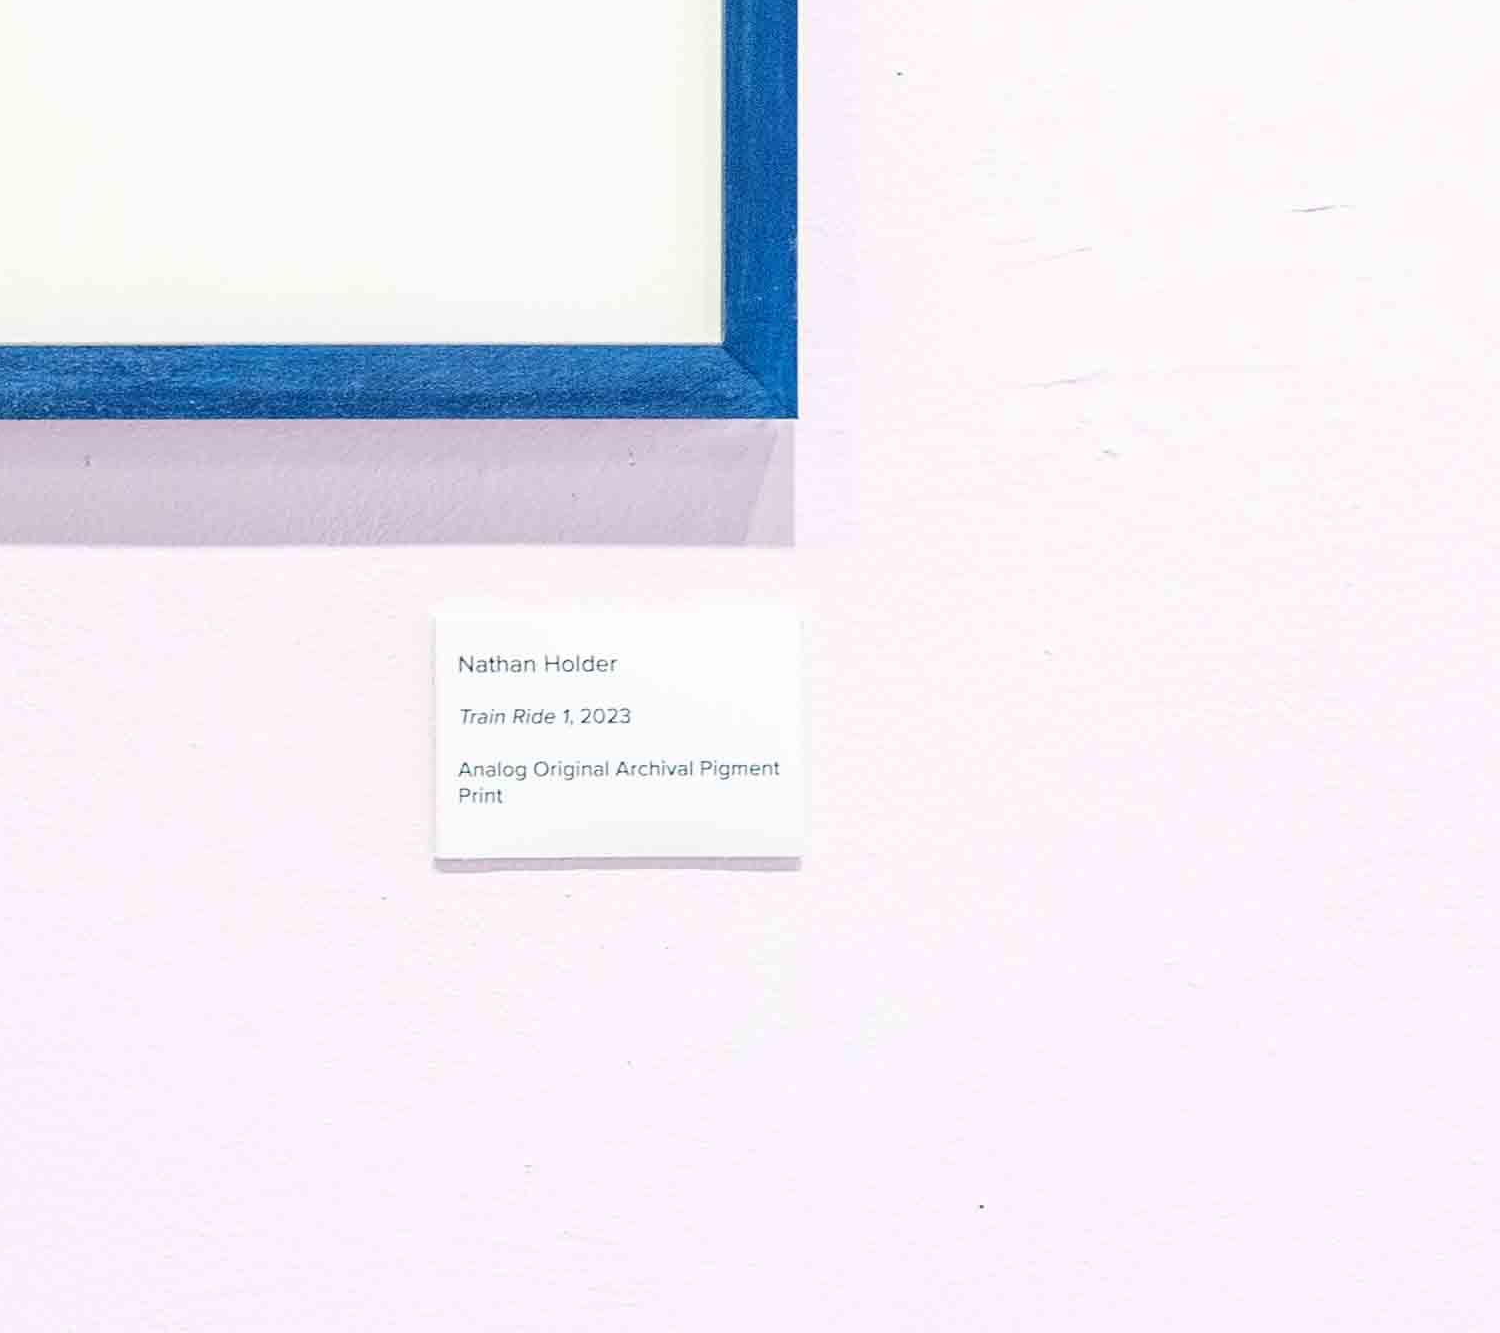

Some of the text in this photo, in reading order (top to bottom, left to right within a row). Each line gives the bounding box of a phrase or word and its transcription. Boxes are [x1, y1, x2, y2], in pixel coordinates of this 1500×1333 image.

[458, 654, 619, 674] Nathan Holder
[459, 707, 632, 726] Train Ride 1, 2023
[457, 759, 781, 782] Analog Original Archival Pigment
[459, 787, 504, 805] Print
